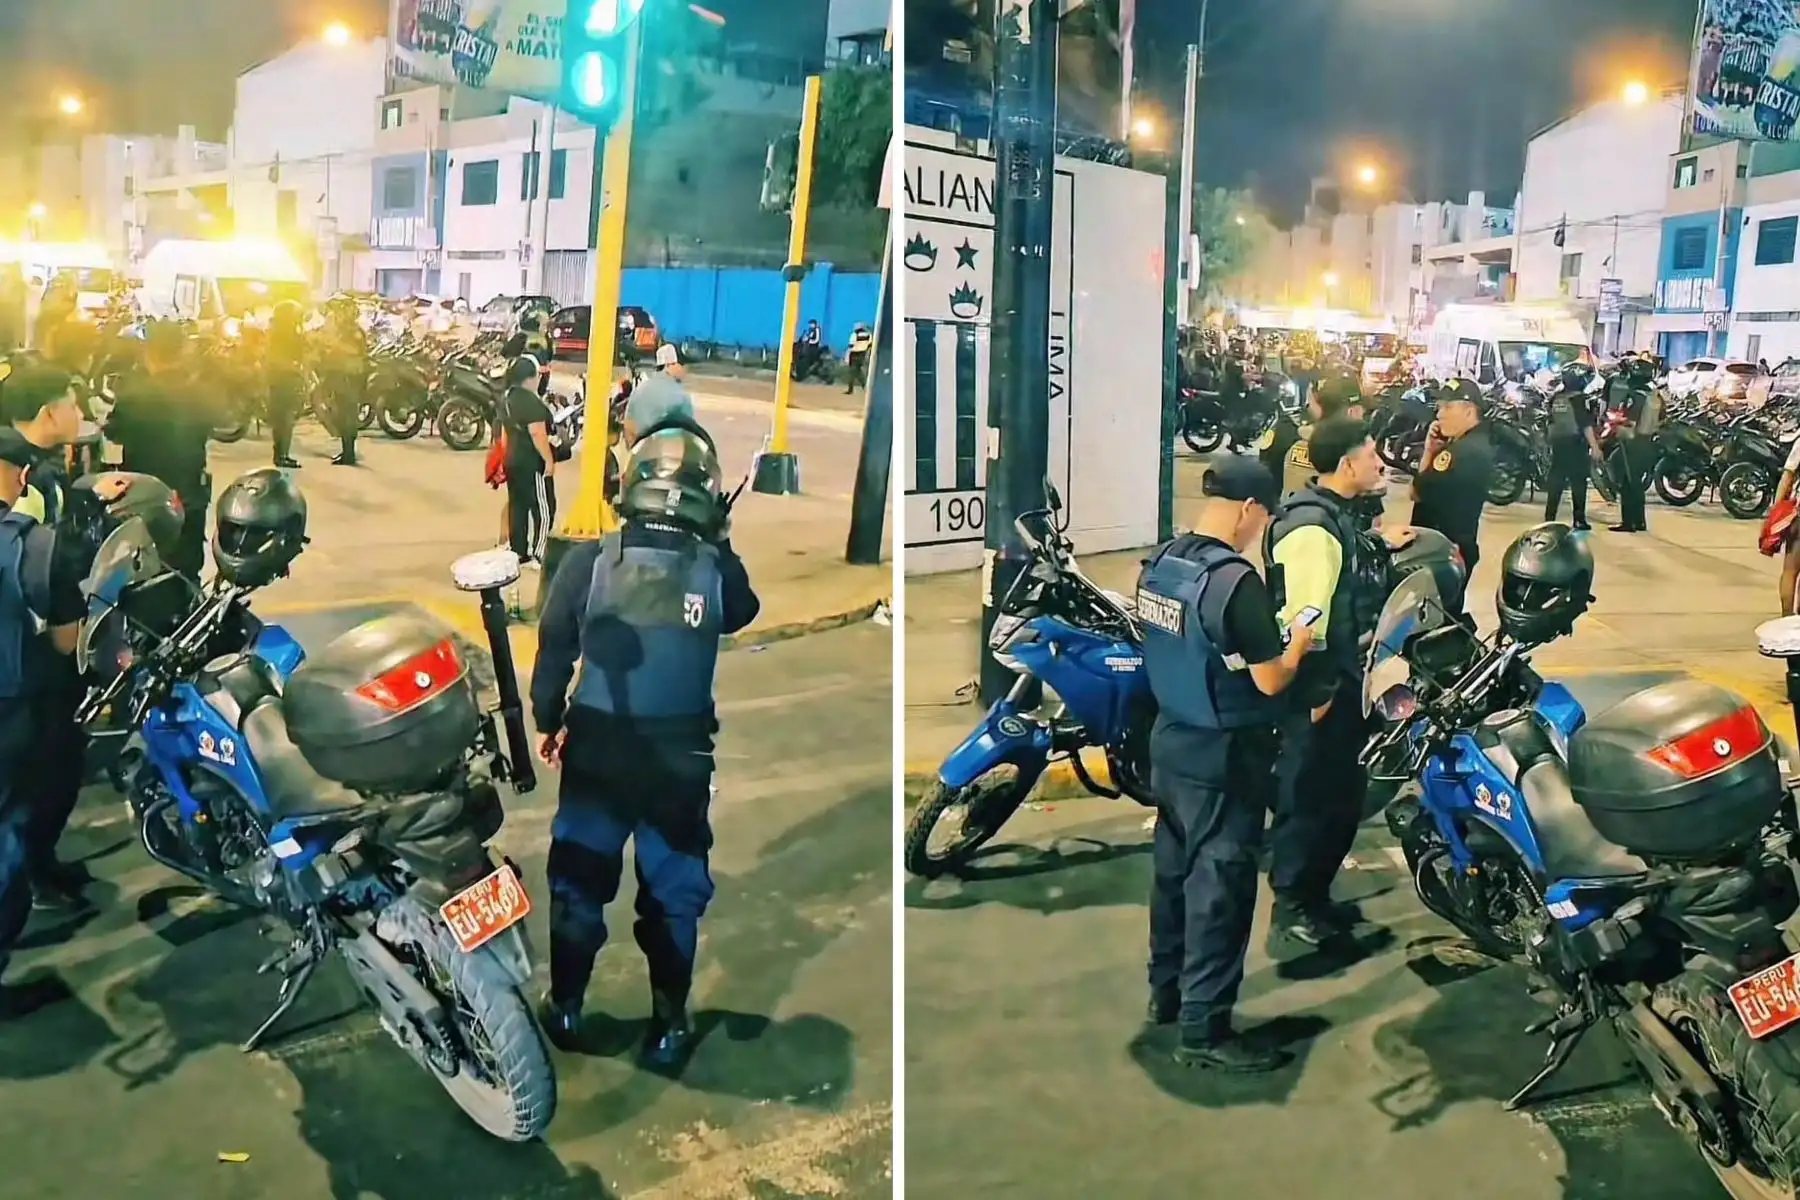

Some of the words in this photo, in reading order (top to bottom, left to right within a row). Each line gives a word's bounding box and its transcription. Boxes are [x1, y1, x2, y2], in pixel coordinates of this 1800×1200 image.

[517, 38, 562, 60] MAT
[930, 496, 984, 532] 190
[1753, 966, 1787, 990] PERU
